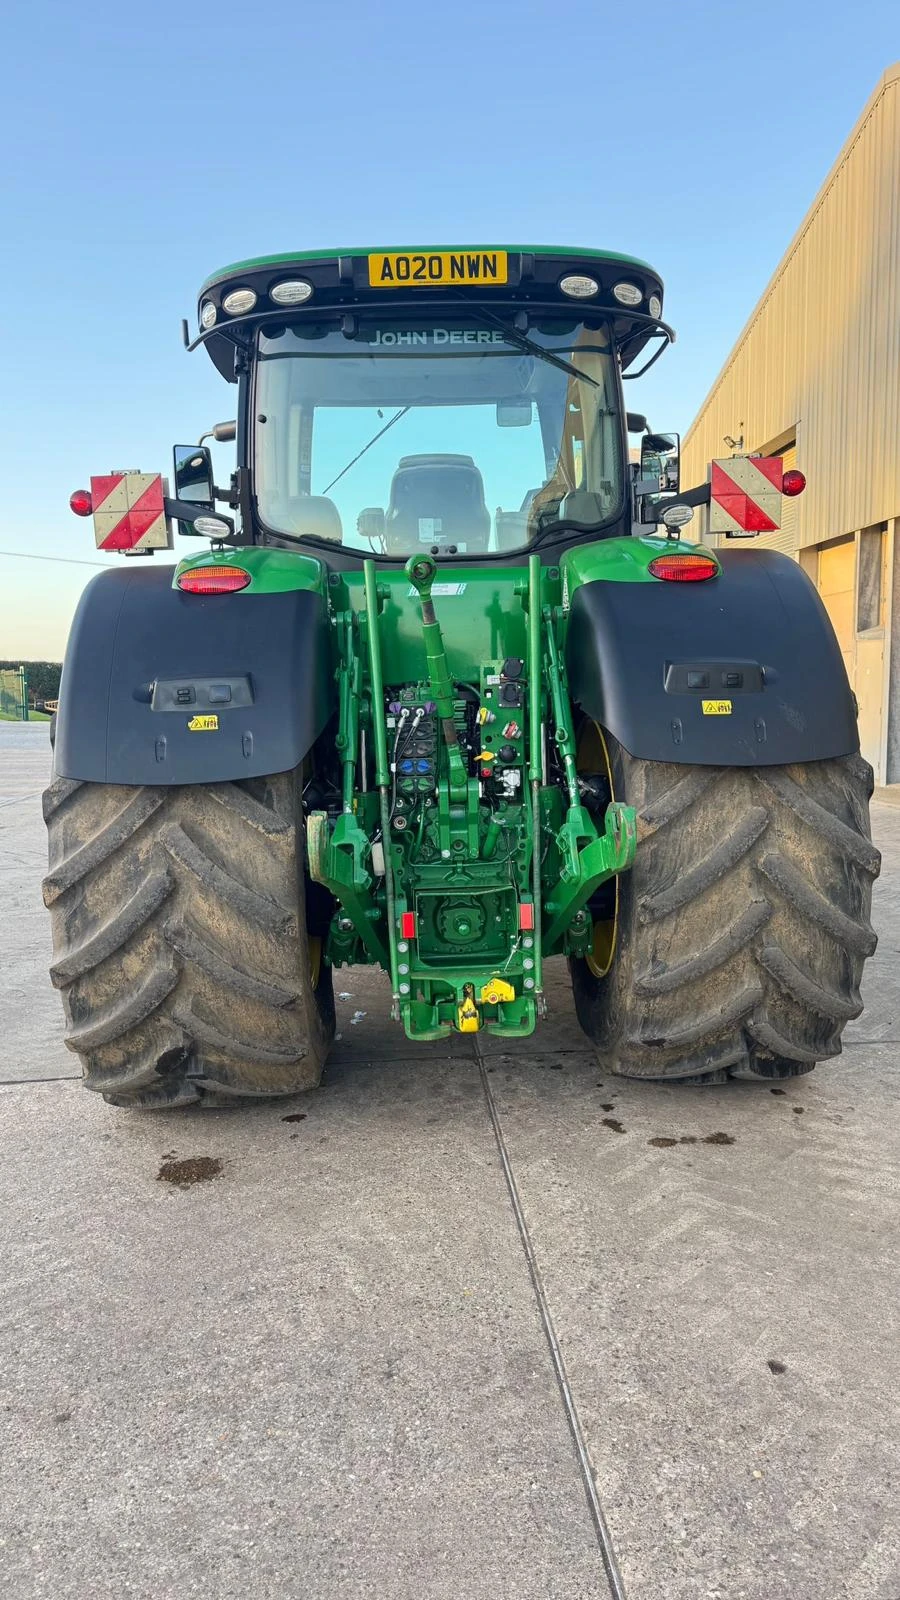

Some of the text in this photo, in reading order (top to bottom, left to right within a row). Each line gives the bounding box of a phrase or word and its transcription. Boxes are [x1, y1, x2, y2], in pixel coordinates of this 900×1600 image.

[380, 254, 498, 281] AO20 NWN
[369, 328, 505, 346] JOHN DEERE
